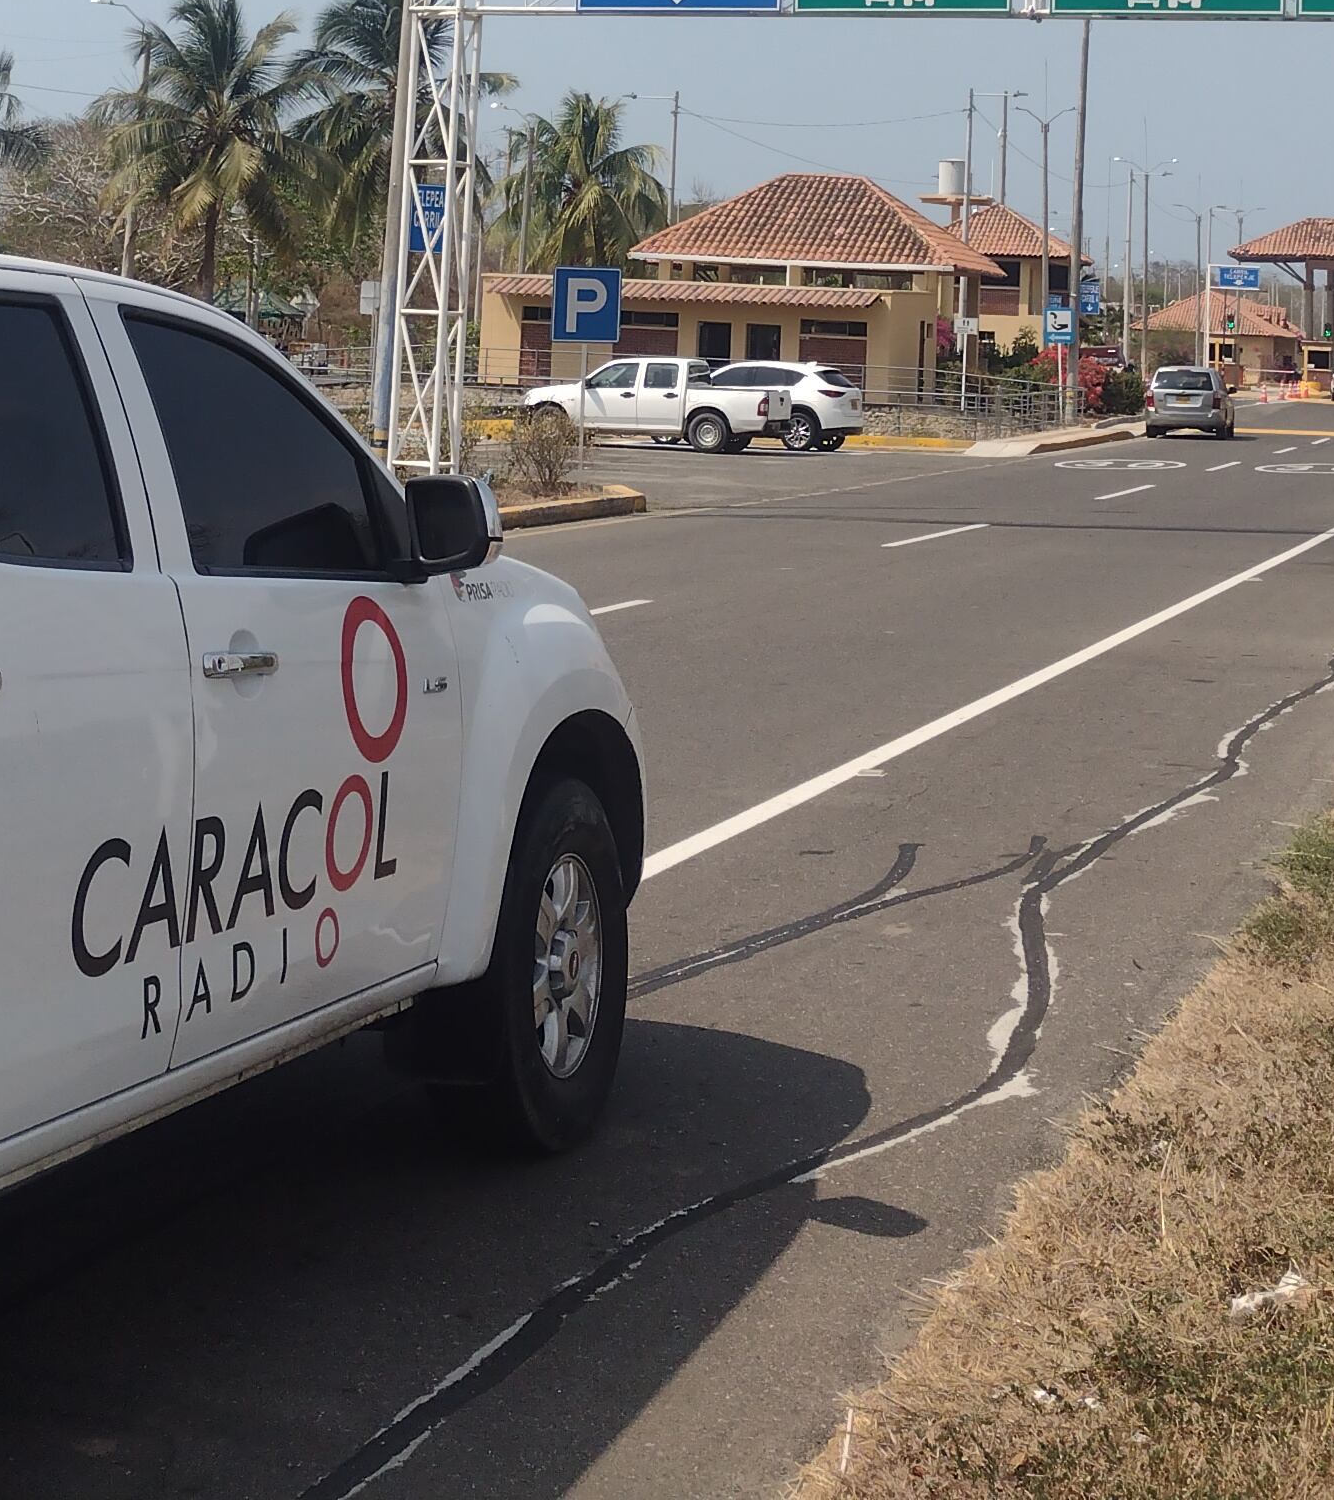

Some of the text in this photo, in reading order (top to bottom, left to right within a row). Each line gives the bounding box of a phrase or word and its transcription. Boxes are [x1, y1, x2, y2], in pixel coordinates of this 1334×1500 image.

[566, 278, 607, 333] P
[466, 582, 494, 601] PRISA
[71, 771, 397, 978] CARACOL
[141, 907, 340, 1039] RADIO
